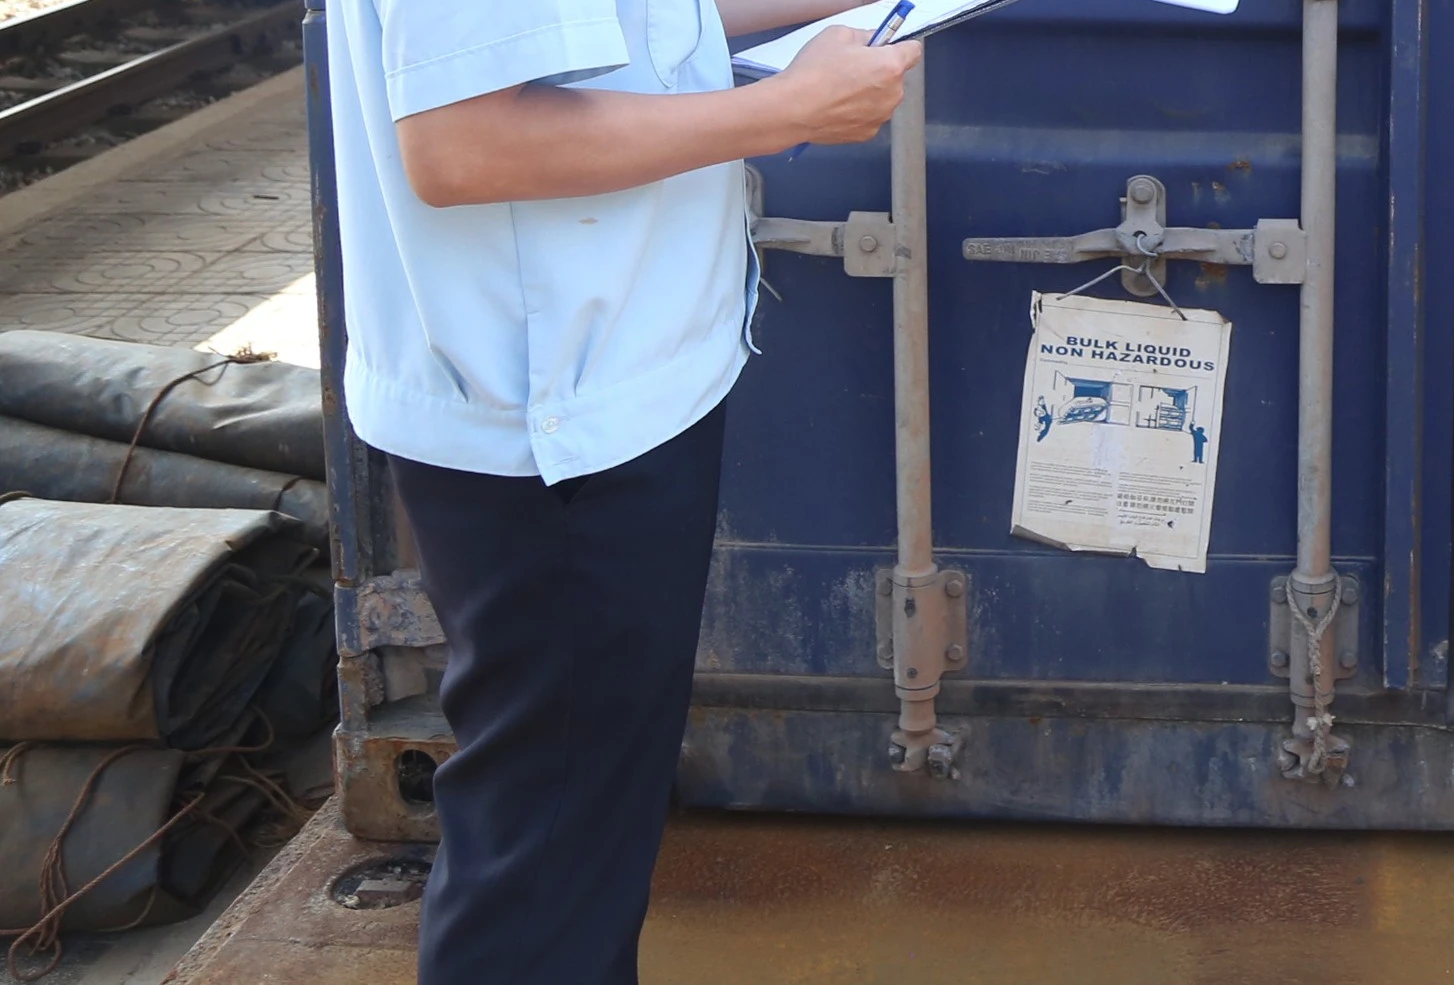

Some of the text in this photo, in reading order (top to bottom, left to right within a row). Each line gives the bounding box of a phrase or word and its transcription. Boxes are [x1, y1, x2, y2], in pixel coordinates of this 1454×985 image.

[1041, 344, 1216, 371] NON HAZARDOUS
[1066, 336, 1192, 357] BULK LIQUID
